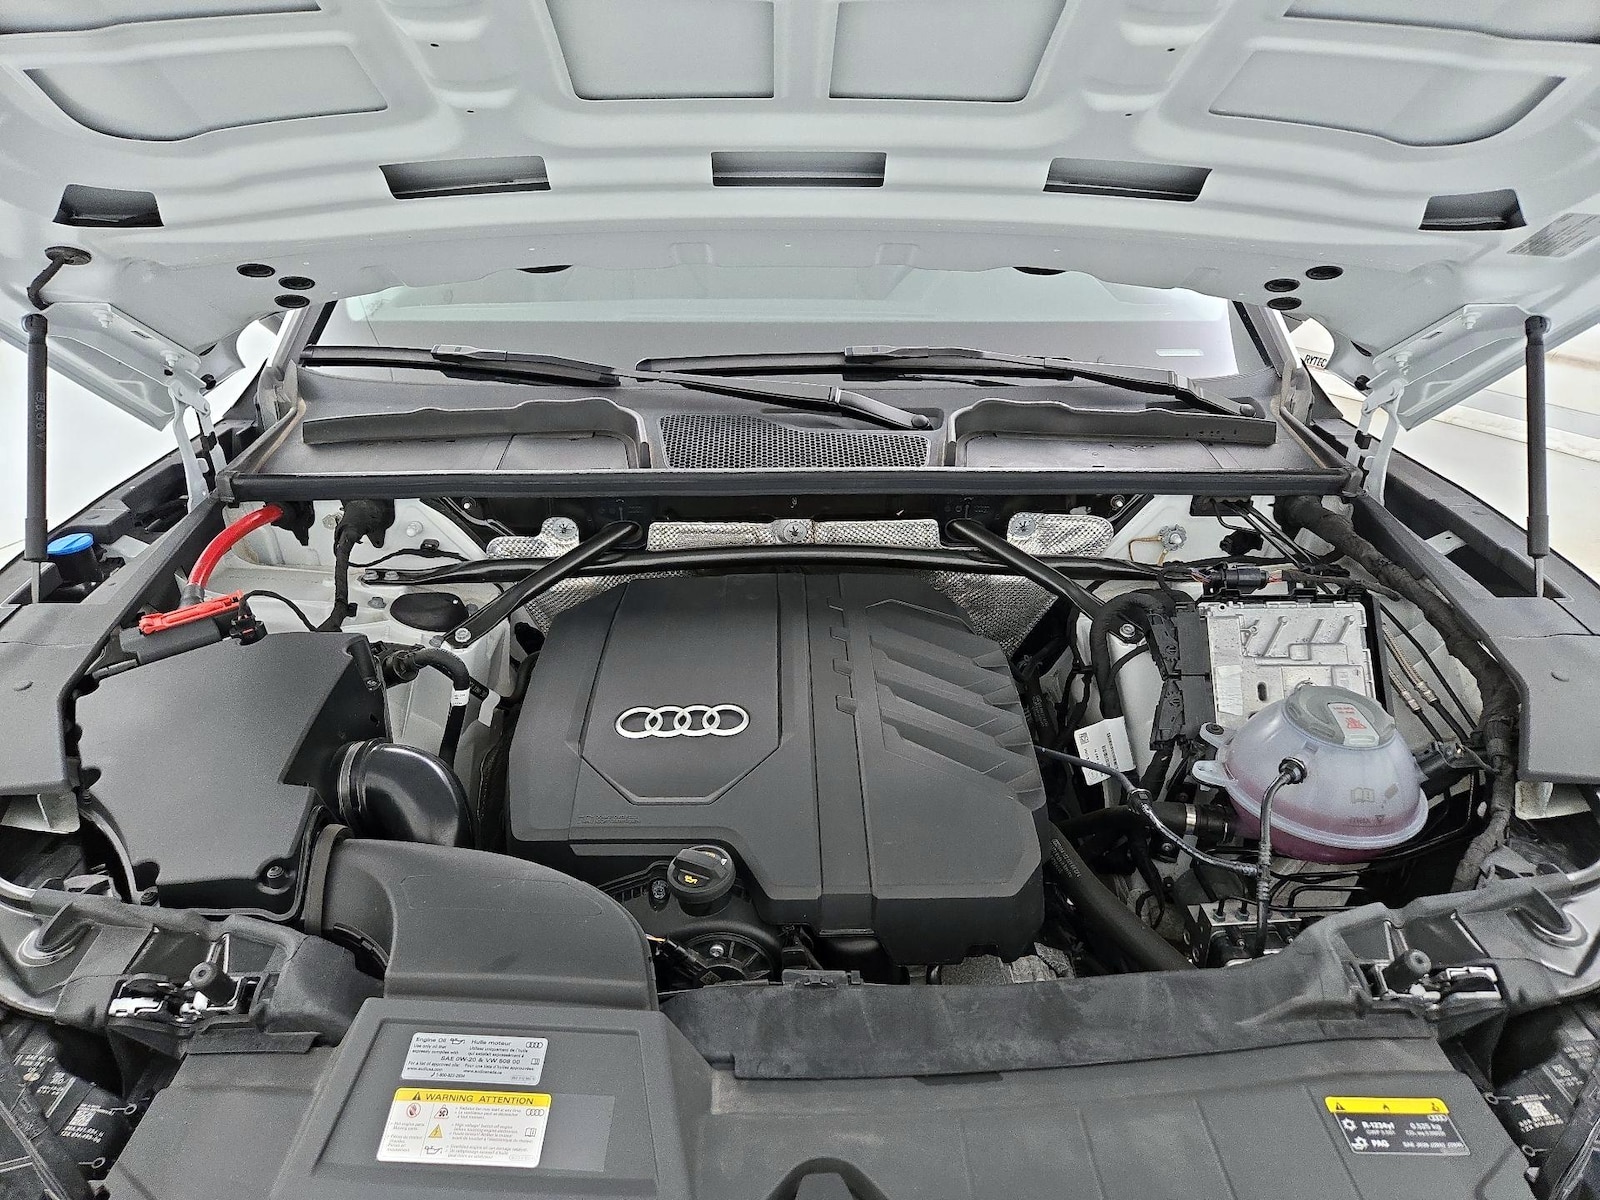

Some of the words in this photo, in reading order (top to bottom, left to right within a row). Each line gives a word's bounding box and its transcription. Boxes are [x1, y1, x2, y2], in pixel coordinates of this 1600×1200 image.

[1304, 354, 1328, 368] RYTEC
[426, 1093, 473, 1102] WARNING
[479, 1095, 534, 1105] ATTENTION
[1370, 1138, 1390, 1148] PAG
